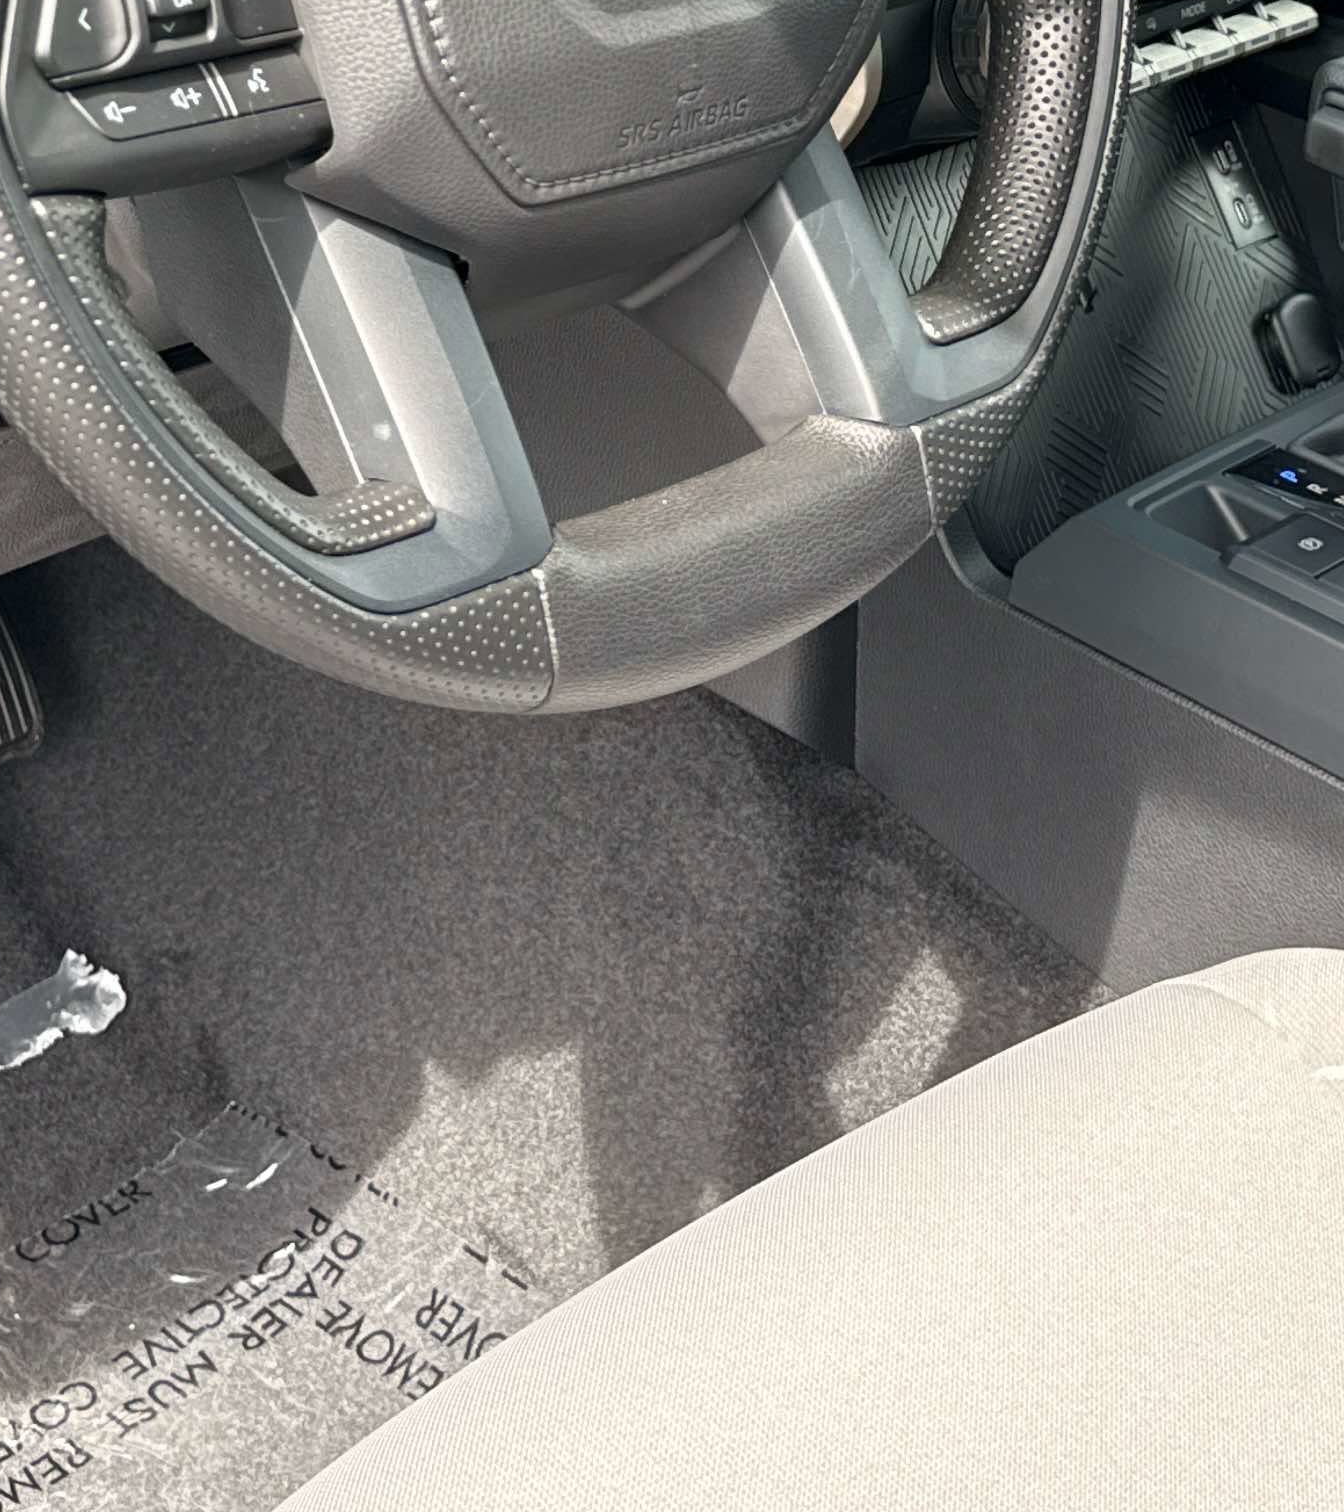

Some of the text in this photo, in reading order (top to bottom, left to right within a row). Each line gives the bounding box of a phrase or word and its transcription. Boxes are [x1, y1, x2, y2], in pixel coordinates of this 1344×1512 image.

[111, 1206, 333, 1381] PROTECTIVE
[227, 1229, 365, 1351] DEALER
[106, 1349, 219, 1439] MUST
[315, 1299, 445, 1401] EMOVE
